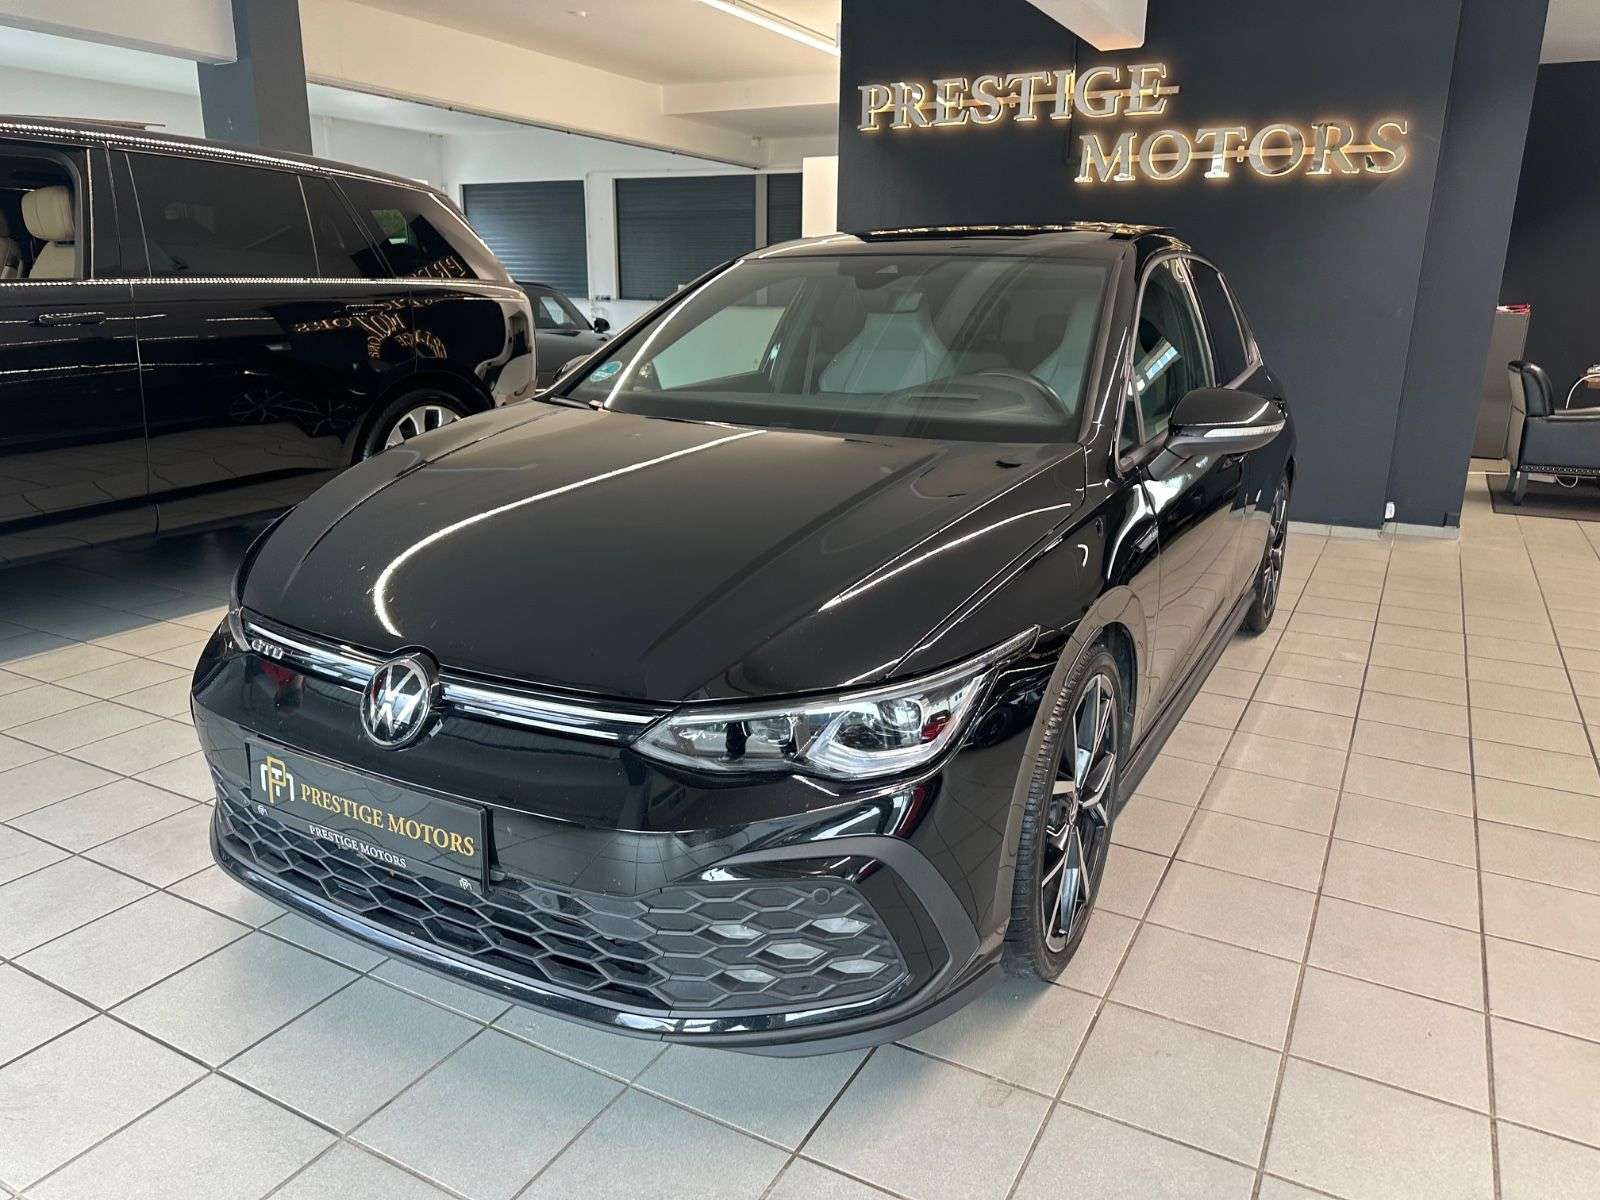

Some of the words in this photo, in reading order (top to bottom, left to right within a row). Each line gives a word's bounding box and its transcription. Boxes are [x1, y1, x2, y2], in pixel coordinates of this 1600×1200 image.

[857, 62, 1168, 131] PRESTIGE
[1074, 120, 1408, 184] MOTORS
[251, 639, 283, 660] GTD
[300, 783, 384, 829] PRESTIGE
[387, 812, 475, 857] MOTORS
[309, 824, 359, 851] PRESTIGE
[359, 842, 407, 869] MOTORS
